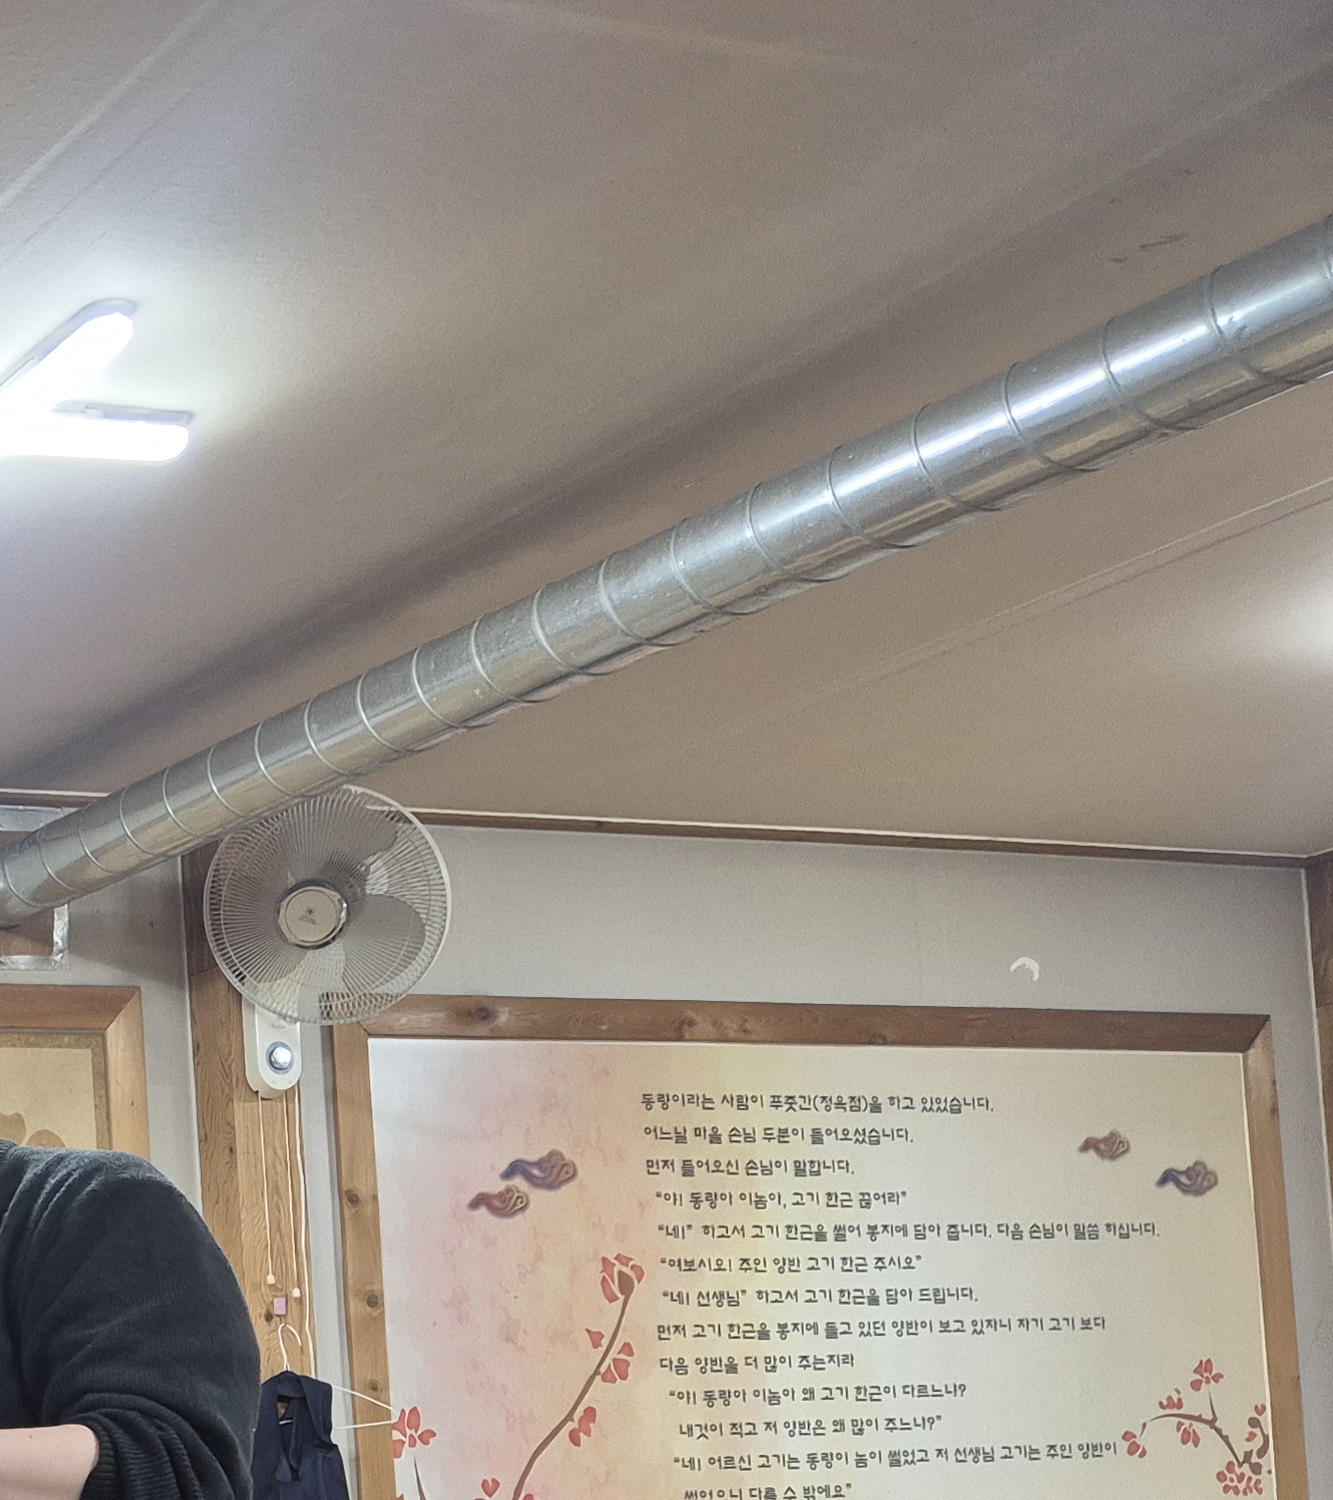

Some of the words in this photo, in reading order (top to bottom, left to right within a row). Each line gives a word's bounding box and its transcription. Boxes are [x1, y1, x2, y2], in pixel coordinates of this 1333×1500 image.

[720, 1093, 764, 1110] 사람이
[886, 1095, 917, 1110] 하고
[643, 1125, 689, 1144] 어느날
[693, 1125, 723, 1144] 마을
[727, 1126, 757, 1143] 손님
[761, 1126, 805, 1144] 두분이
[809, 1126, 914, 1145] 들어오셨습니다.
[645, 1158, 676, 1175] 먼저
[680, 1158, 740, 1177] 들어오신
[744, 1158, 788, 1176] 손님이
[792, 1158, 855, 1177] 말합니다.
[738, 1191, 787, 1209] 이놈아,
[790, 1191, 820, 1205] 고기
[824, 1190, 854, 1208] 한근
[700, 1223, 746, 1239] 하고서
[750, 1224, 780, 1238] 고기
[784, 1223, 828, 1242] 한근을
[832, 1223, 862, 1242] 썰어
[865, 1223, 909, 1242] 봉지에
[913, 1222, 942, 1240] 담아
[996, 1222, 1024, 1240] 다음
[1028, 1222, 1069, 1239] 손님이
[1073, 1222, 1100, 1240] 말씀
[1104, 1222, 1161, 1239] 하십니다.
[738, 1256, 768, 1273] 주인
[772, 1256, 802, 1274] 양반
[805, 1255, 835, 1270] 고기
[839, 1255, 869, 1272] 한근
[755, 1288, 799, 1304] 하고서
[803, 1288, 833, 1303] 고기
[836, 1287, 881, 1306] 한근을
[884, 1287, 914, 1305] 담아
[917, 1286, 979, 1304] 드립니다.
[656, 1323, 687, 1341] 먼저
[691, 1322, 722, 1338] 고기
[726, 1321, 772, 1340] 한근을
[775, 1321, 820, 1340] 봉지에
[823, 1321, 854, 1339] 들고
[857, 1319, 887, 1337] 있던
[891, 1319, 933, 1337] 양반이
[937, 1319, 967, 1333] 보고
[970, 1317, 1012, 1335] 있자니
[1016, 1316, 1044, 1331] 자기
[1048, 1316, 1076, 1331] 고기
[1079, 1316, 1106, 1330] 보다
[658, 1356, 690, 1375] 다음
[694, 1355, 739, 1375] 양반을
[743, 1355, 759, 1370] 더
[763, 1354, 793, 1373] 많이
[797, 1352, 855, 1371] 주는지라
[752, 1387, 796, 1406] 이놈아
[801, 1386, 816, 1401] 왜
[820, 1385, 850, 1400] 고기
[853, 1384, 897, 1402] 한근이
[678, 1422, 724, 1440] 내것이
[728, 1421, 759, 1438] 적고
[762, 1420, 778, 1435] 저
[782, 1418, 827, 1437] 양반은
[831, 1418, 846, 1432] 왜
[849, 1416, 879, 1436] 많이
[707, 1454, 753, 1471] 어르신
[756, 1453, 801, 1470] 고기는
[853, 1449, 882, 1468] 놈이
[887, 1448, 931, 1468] 썰었고
[934, 1447, 949, 1461] 저
[953, 1445, 995, 1464] 선생님
[999, 1444, 1042, 1461] 고기는
[1045, 1442, 1074, 1459] 주인
[1077, 1441, 1117, 1460] 양반이
